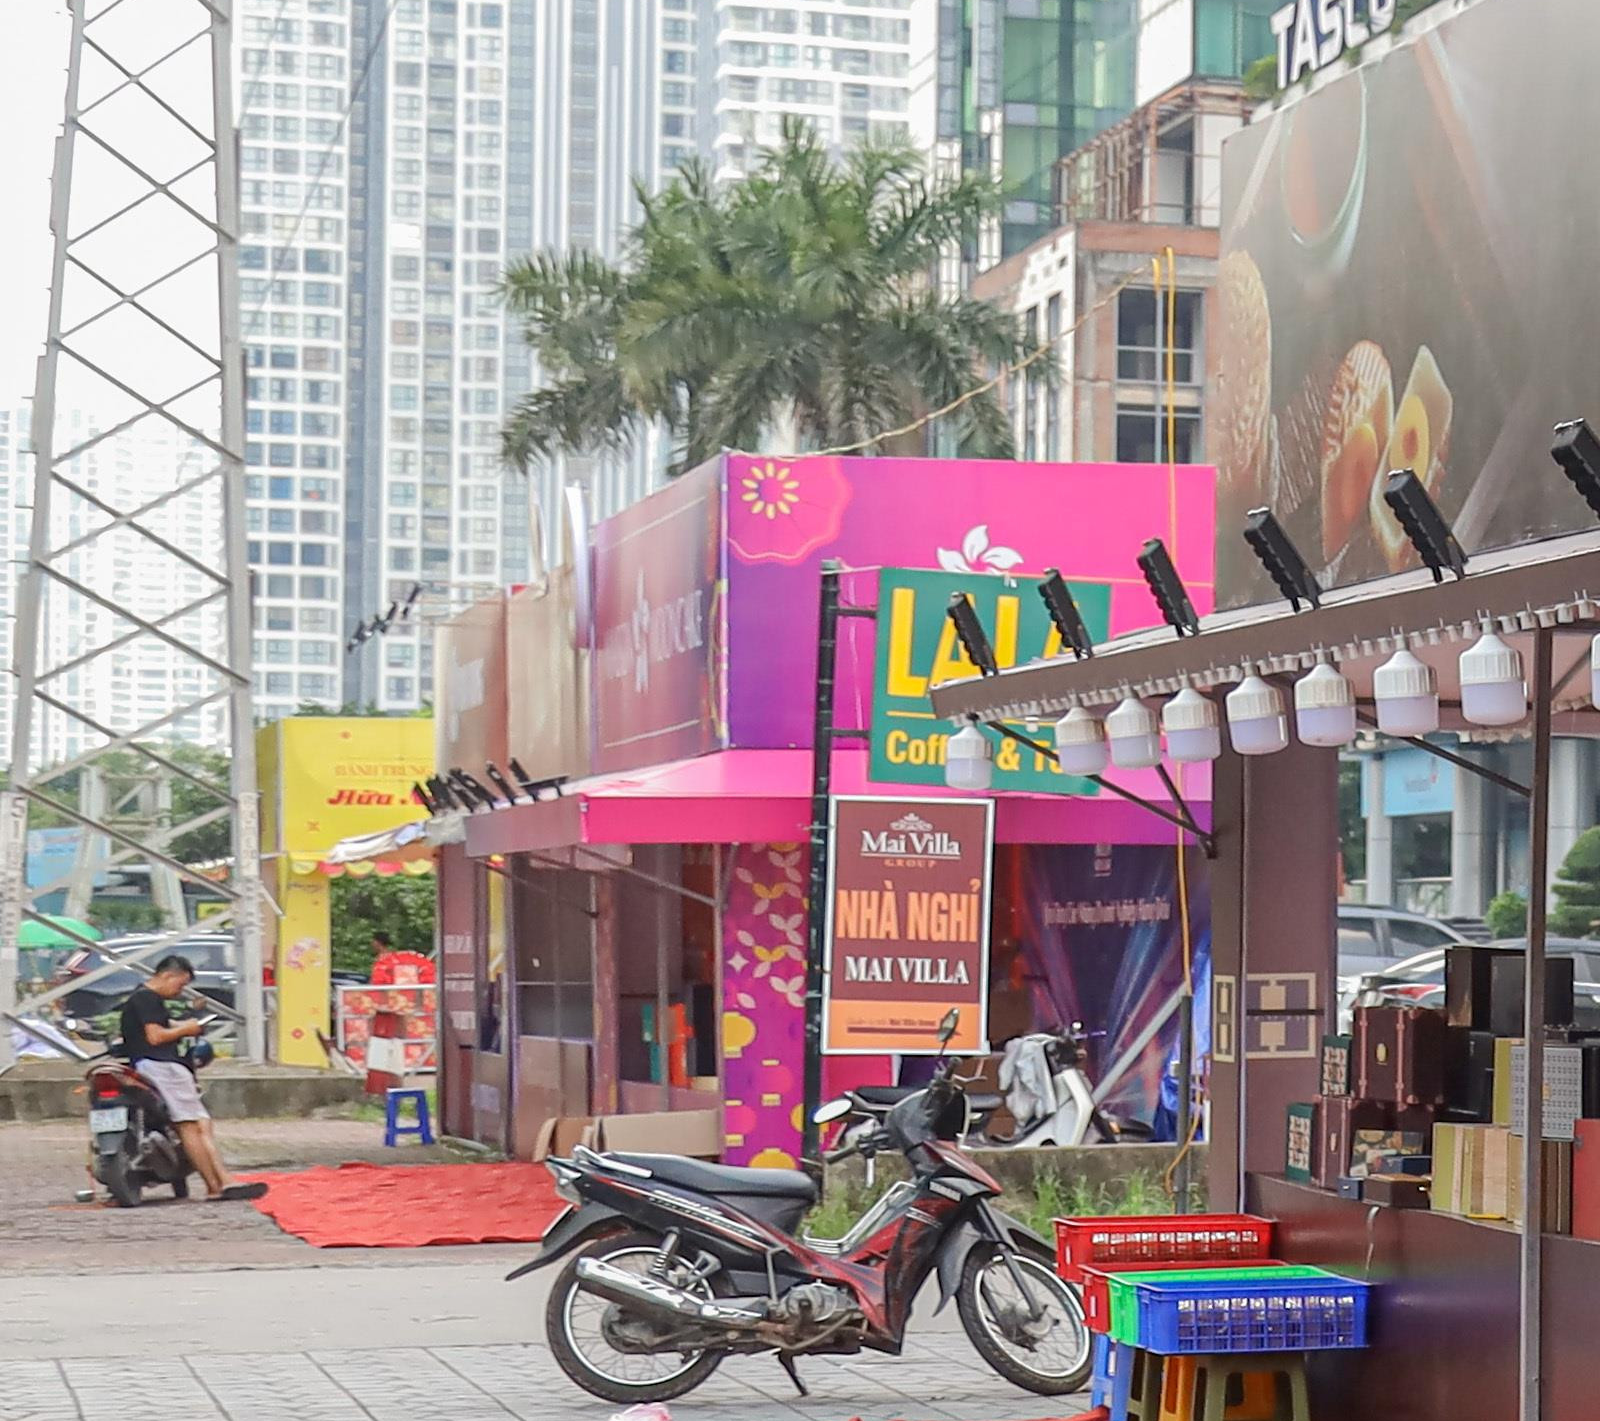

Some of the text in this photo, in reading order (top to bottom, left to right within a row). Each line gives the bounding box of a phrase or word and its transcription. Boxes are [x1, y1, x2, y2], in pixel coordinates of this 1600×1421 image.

[997, 737, 1020, 770] &
[861, 830, 960, 855] Mai Villa
[837, 880, 899, 940] NHÀ
[908, 879, 982, 942] NGHỈ
[845, 956, 969, 984] MAI VILLA
